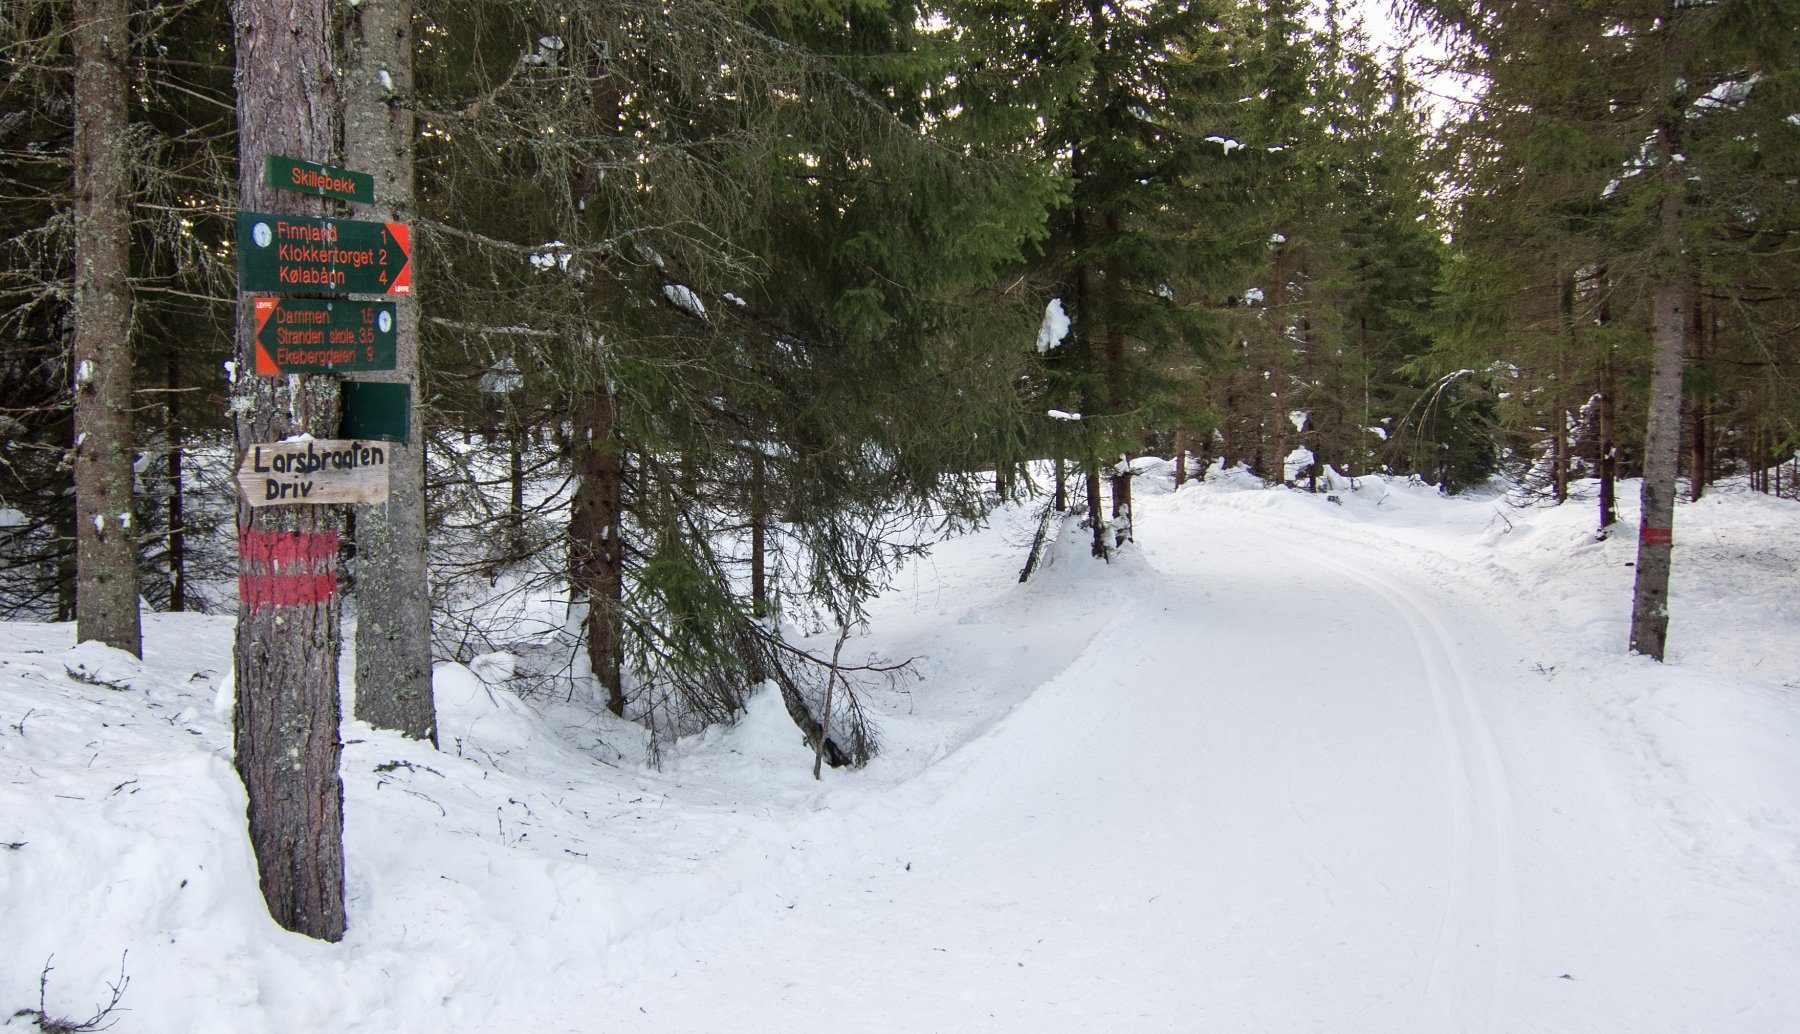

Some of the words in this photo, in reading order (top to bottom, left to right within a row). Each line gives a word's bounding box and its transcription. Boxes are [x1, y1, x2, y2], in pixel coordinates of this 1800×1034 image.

[291, 167, 356, 194] Skillebekk
[277, 221, 338, 242] Finnland
[380, 230, 388, 244] 1
[279, 244, 374, 267] Klokkertorget
[379, 249, 388, 265] 2
[279, 266, 345, 284] Kølabånn
[379, 270, 388, 285] 4
[276, 307, 331, 324] Dammen
[277, 327, 324, 345] Stranden
[329, 328, 355, 344] skole
[276, 347, 356, 366] Ekebergdalen
[366, 346, 374, 362] 9
[254, 441, 384, 474] Larsbraaten
[265, 475, 313, 500] Driv
